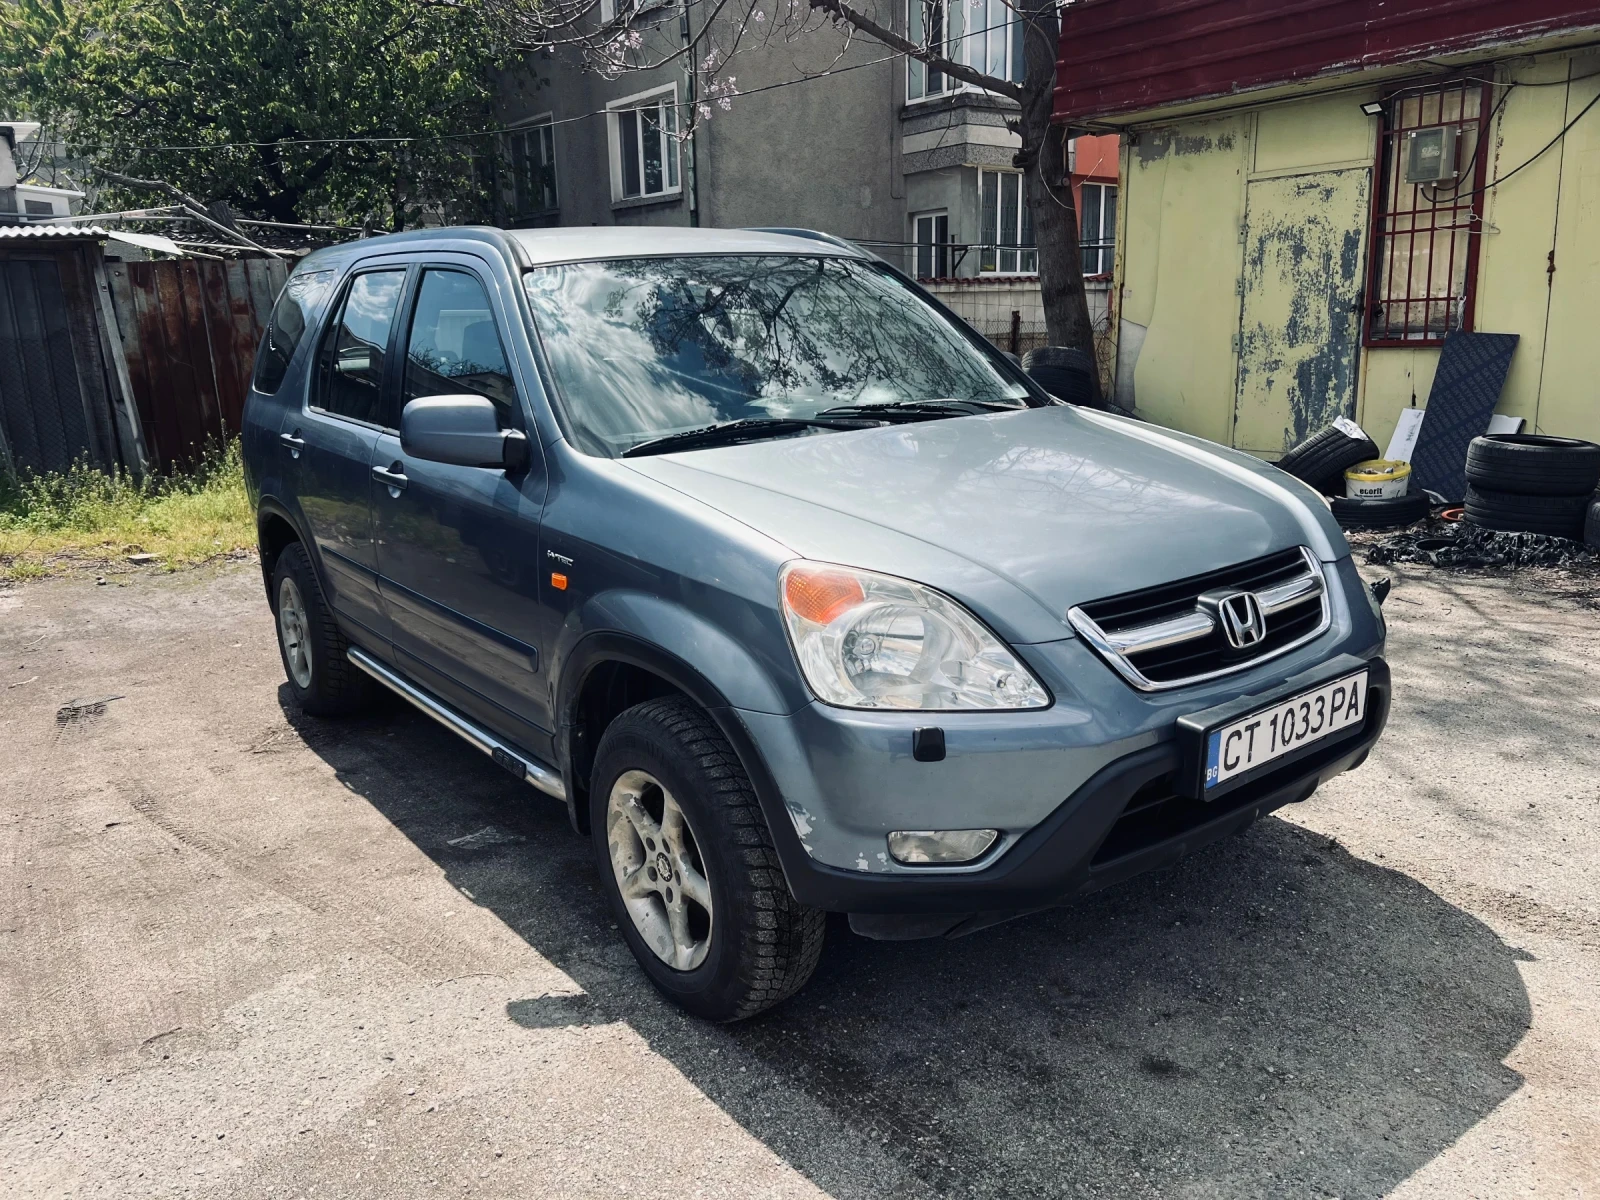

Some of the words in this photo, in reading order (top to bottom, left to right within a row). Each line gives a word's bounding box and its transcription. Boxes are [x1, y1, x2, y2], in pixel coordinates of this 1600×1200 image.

[1224, 720, 1260, 772] CT
[1270, 695, 1325, 753] 1033
[1328, 681, 1359, 727] PA
[1206, 766, 1218, 781] BG
